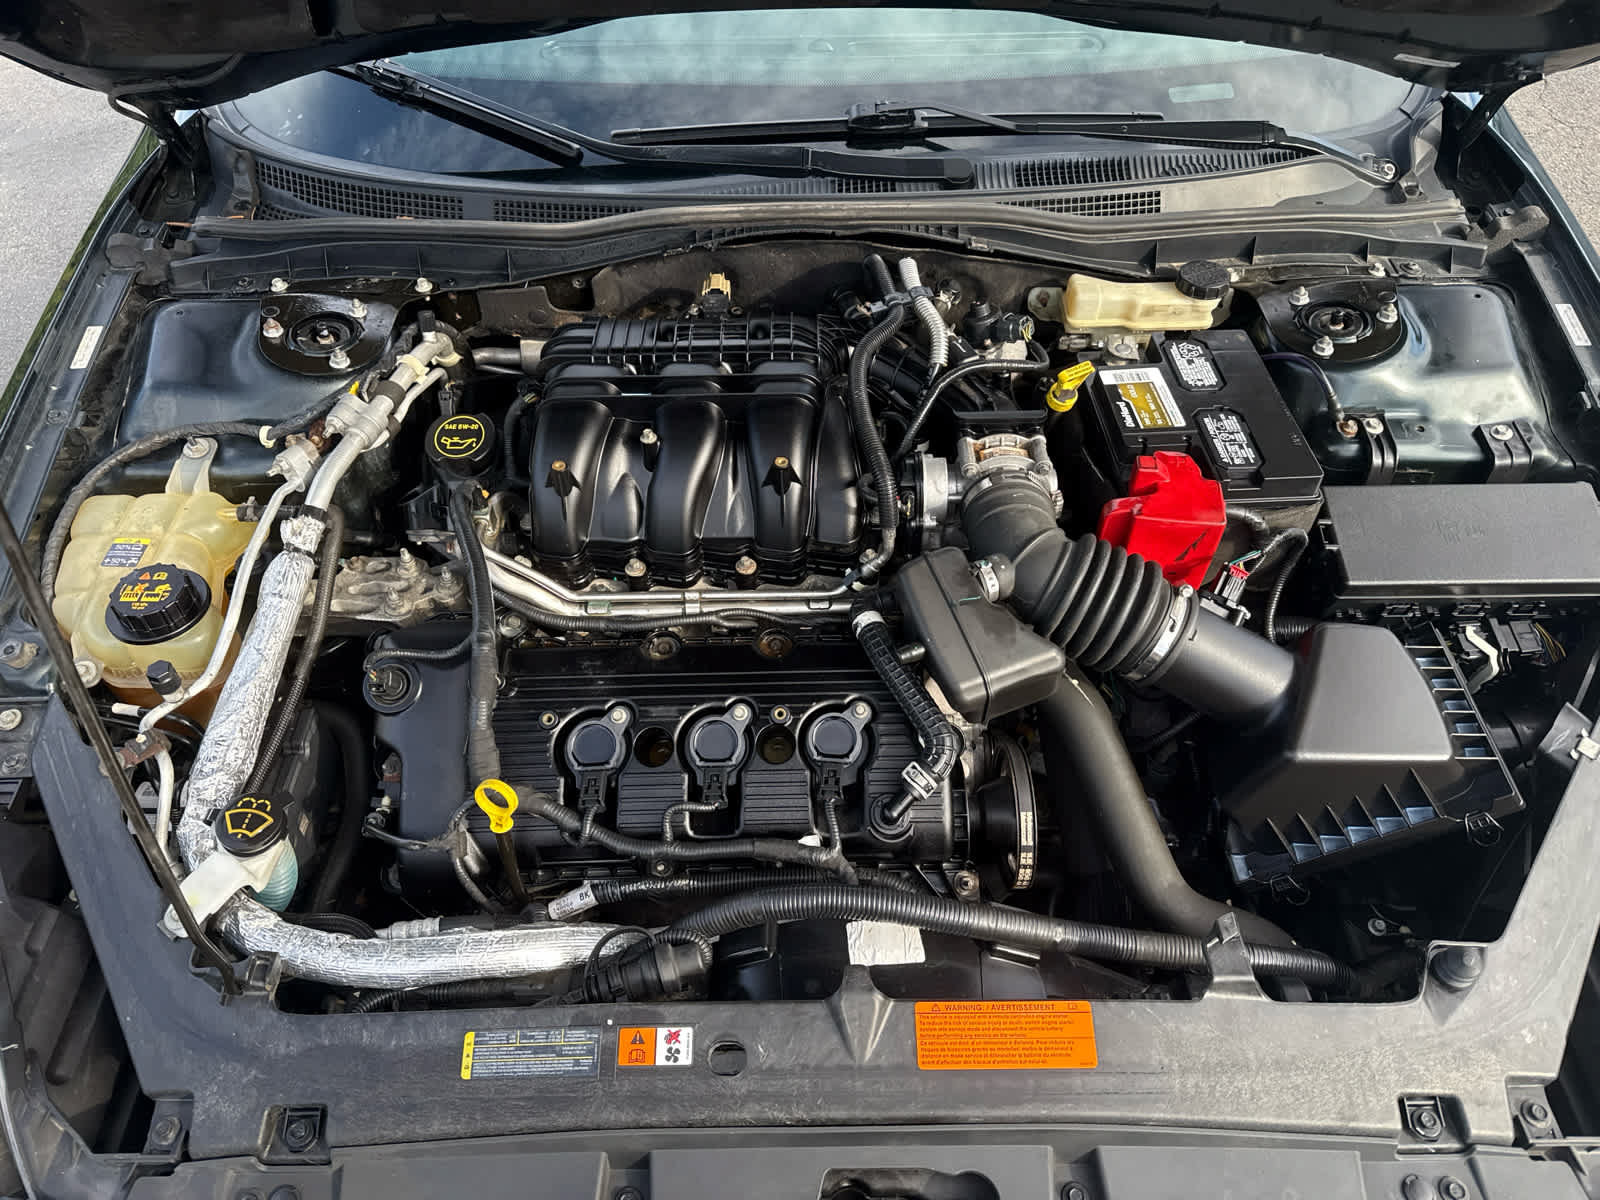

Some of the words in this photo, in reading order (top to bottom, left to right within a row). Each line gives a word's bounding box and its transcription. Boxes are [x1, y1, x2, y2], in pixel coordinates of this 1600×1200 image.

[1116, 401, 1135, 428] DieHard
[579, 890, 590, 901] BK
[991, 1003, 1055, 1011] AVERTISSEMENT
